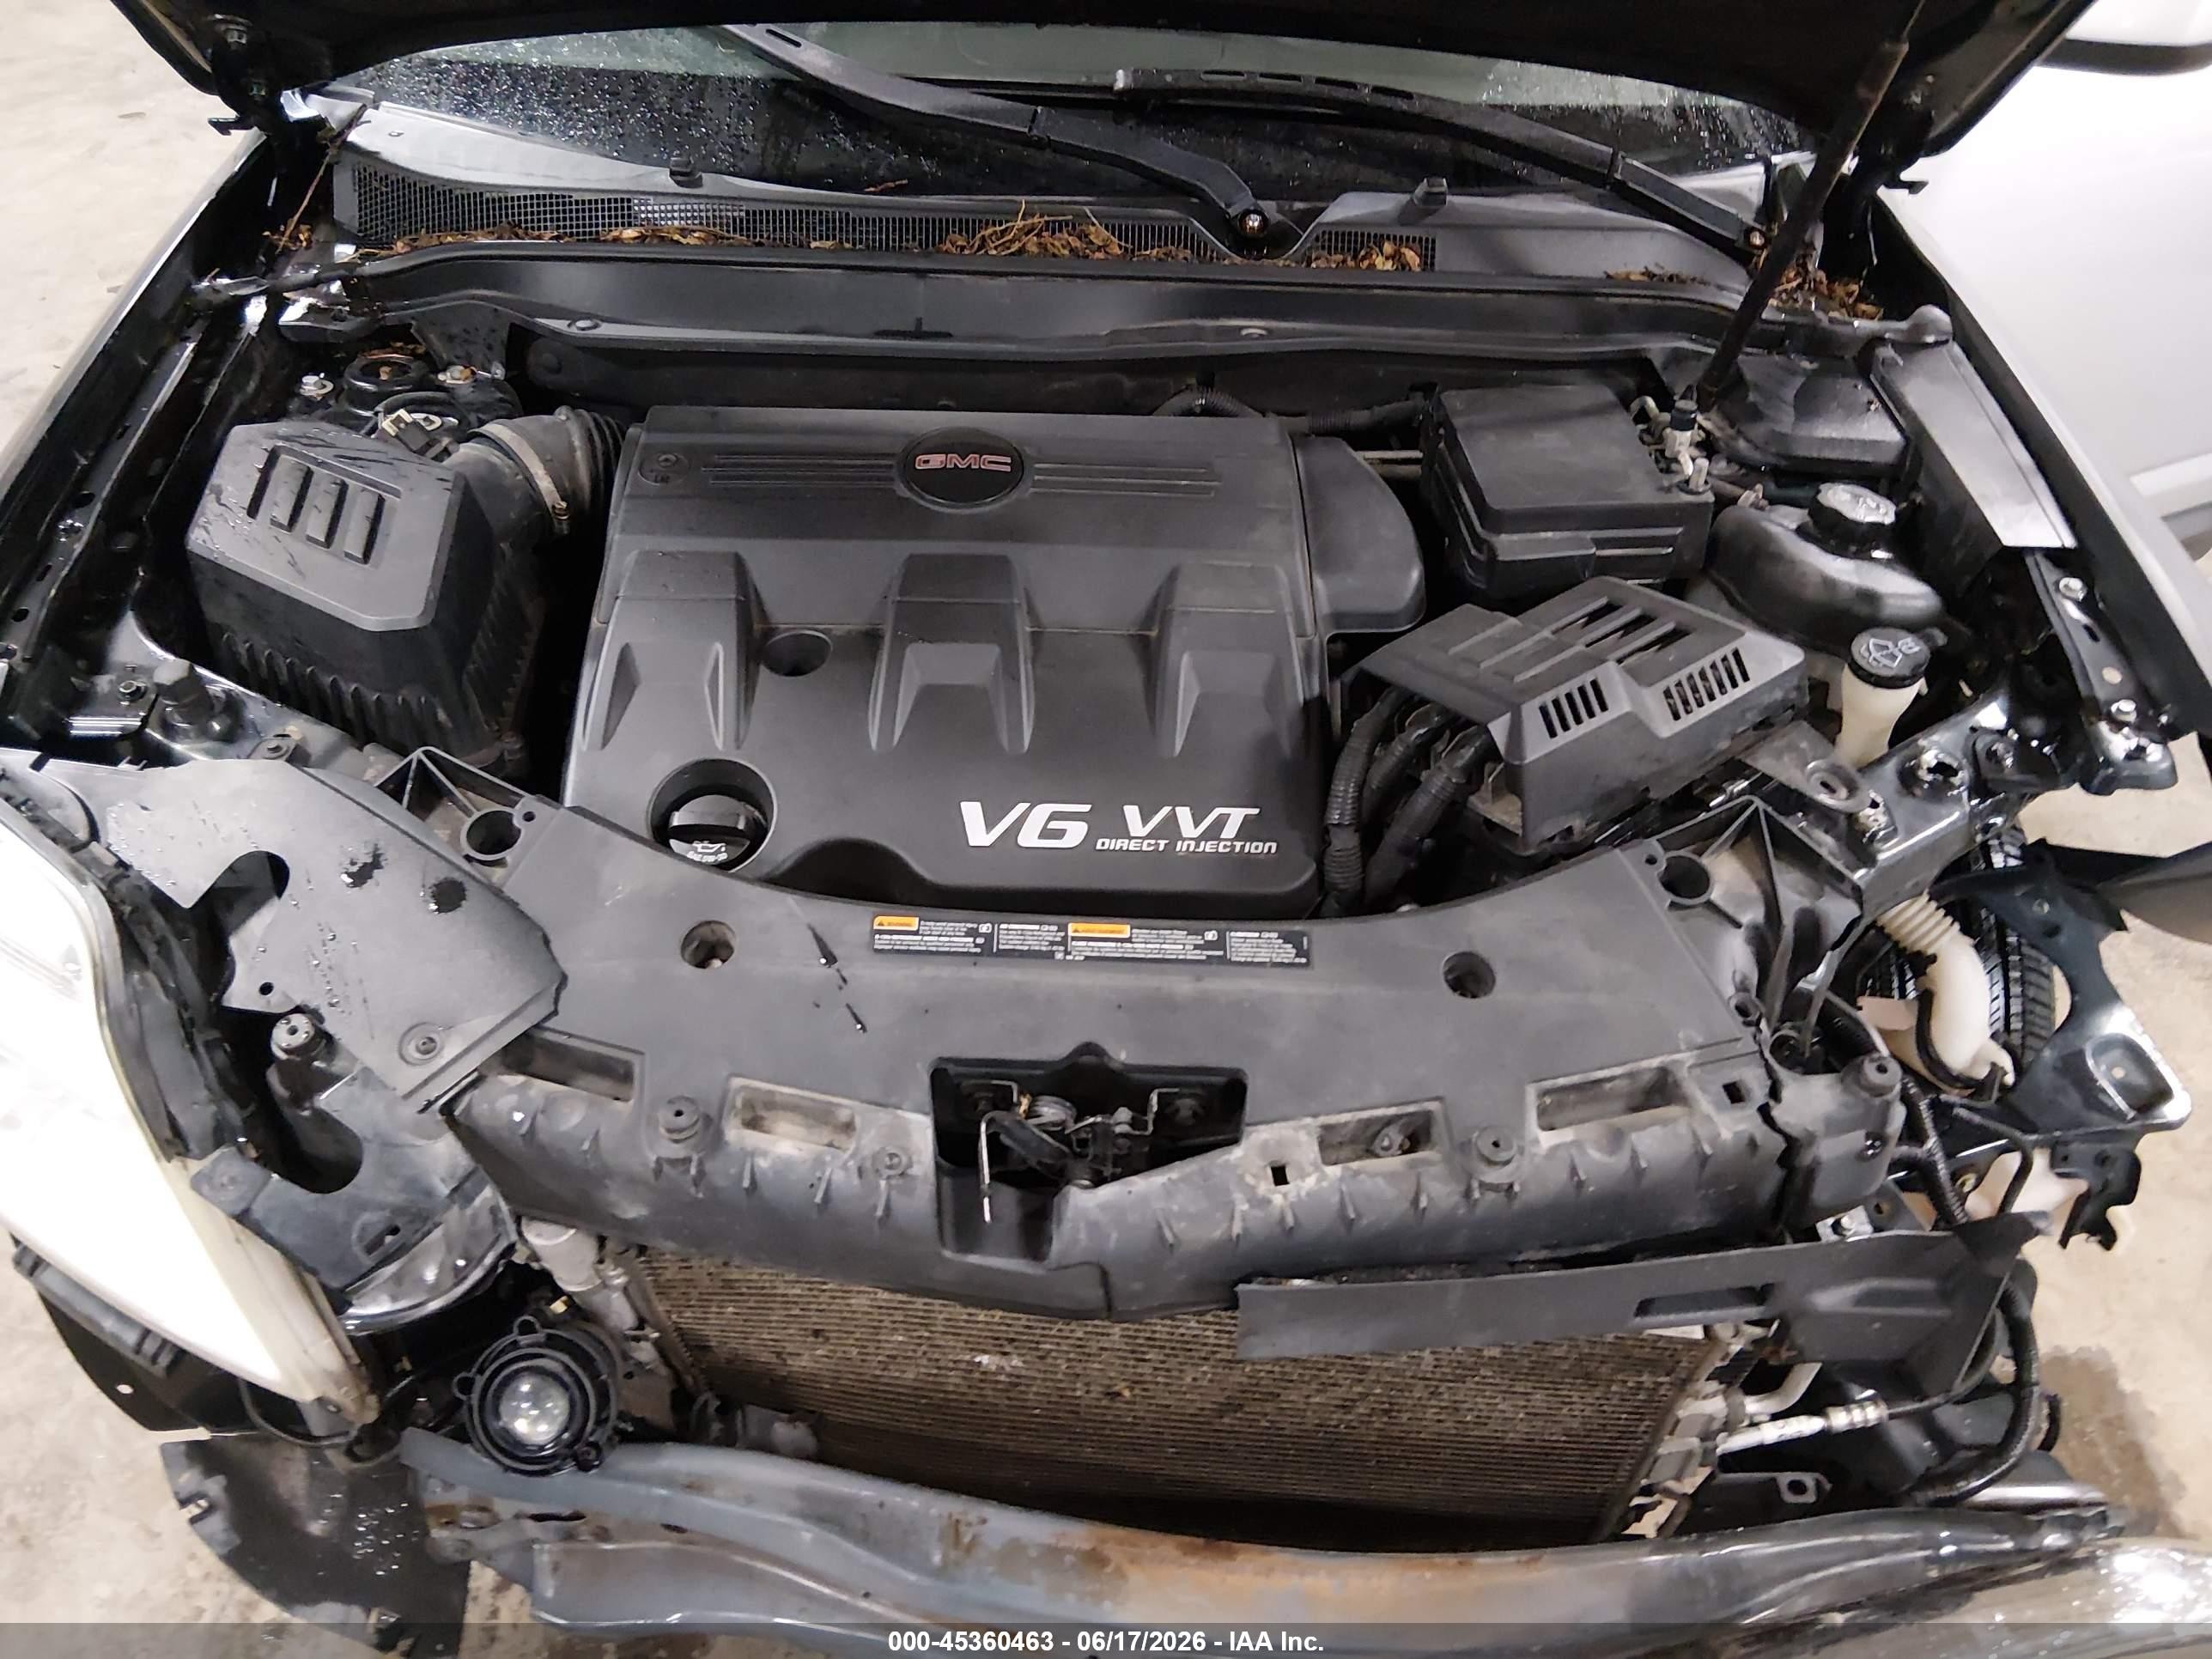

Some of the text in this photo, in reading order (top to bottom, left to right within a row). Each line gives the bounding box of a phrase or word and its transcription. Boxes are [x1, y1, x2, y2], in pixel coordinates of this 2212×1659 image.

[915, 453, 1012, 471] GMC
[959, 800, 1261, 849] V6 VVT
[1096, 838, 1278, 854] DIRECT INJECTION
